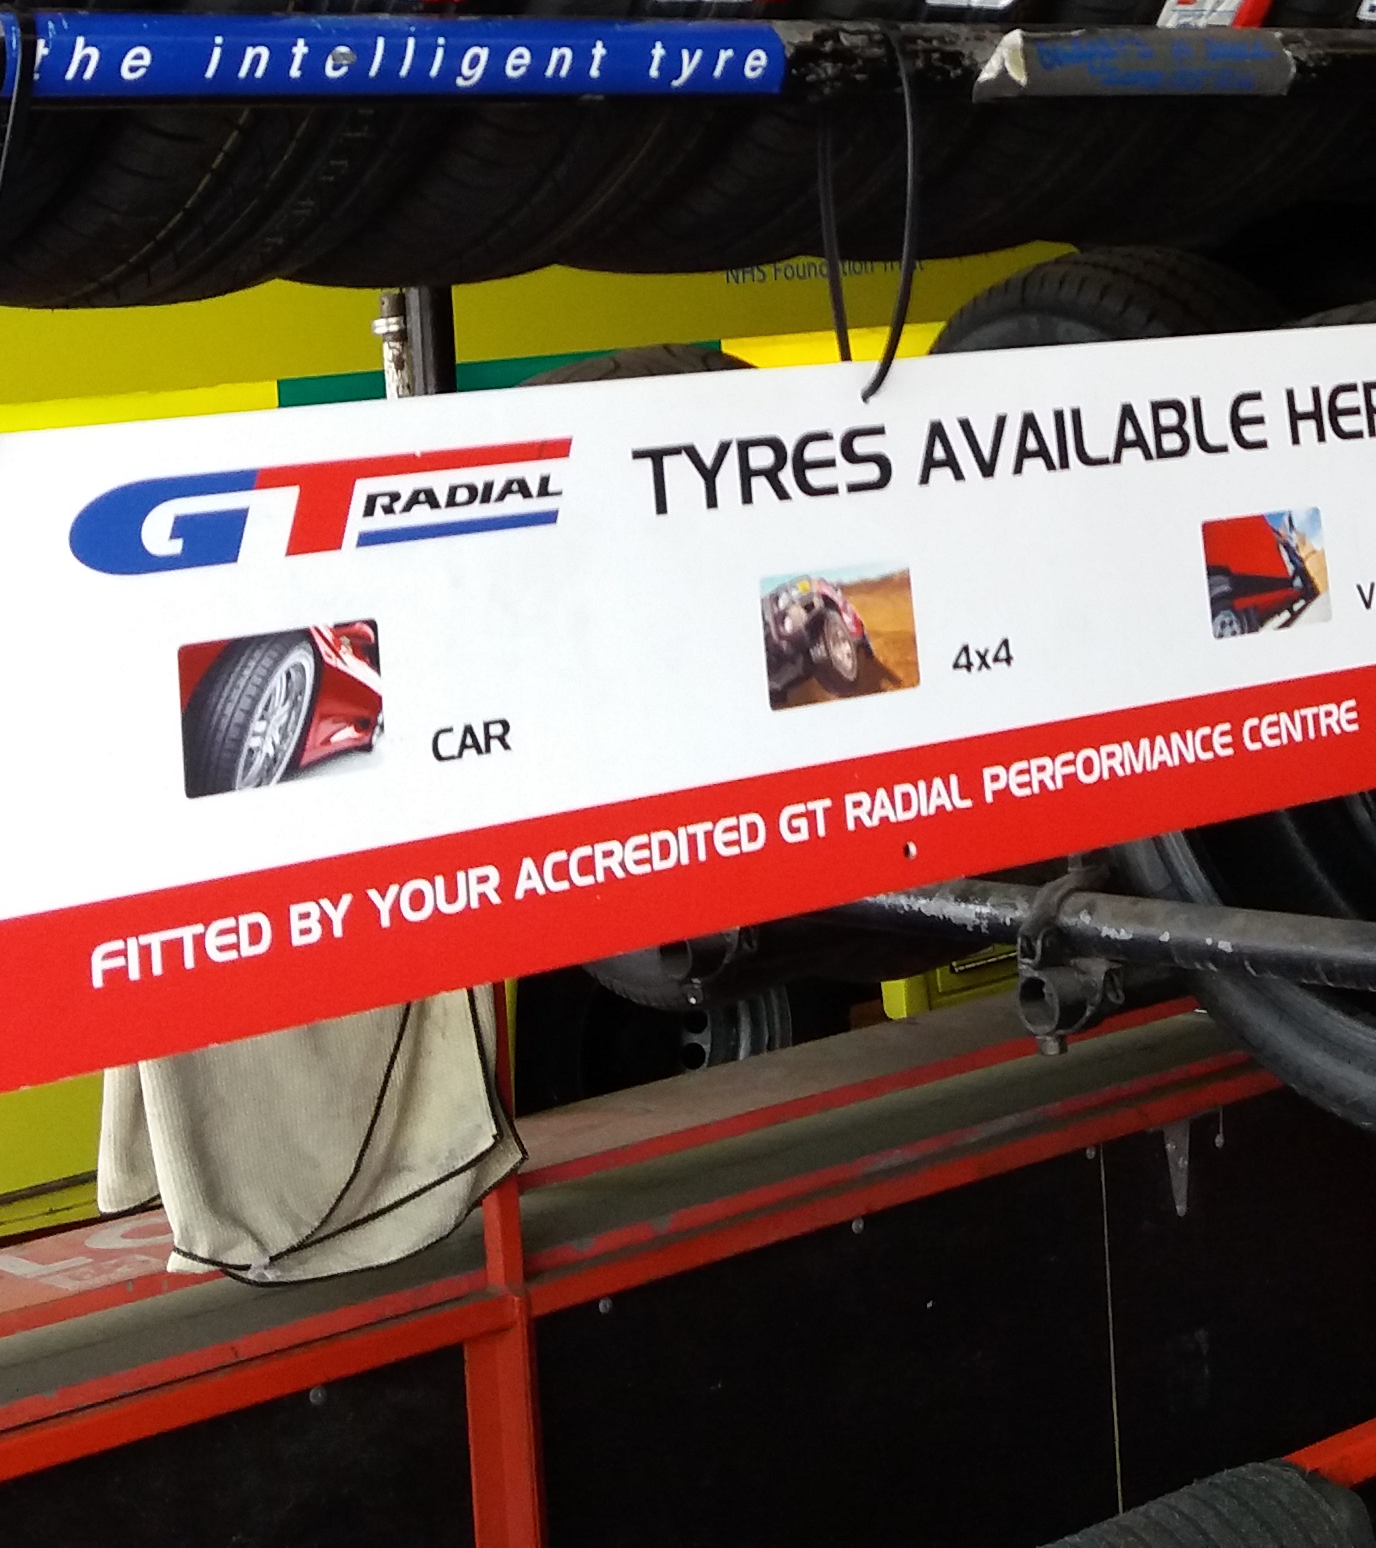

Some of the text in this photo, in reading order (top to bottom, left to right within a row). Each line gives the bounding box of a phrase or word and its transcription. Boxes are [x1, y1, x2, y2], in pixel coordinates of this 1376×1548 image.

[34, 36, 770, 89] the intelligent tyre
[631, 424, 893, 516] TYRES
[918, 390, 1269, 486] AVAILABLE
[68, 436, 573, 575] GT RADIAL
[952, 637, 1014, 675] 4x4
[430, 718, 511, 762] CAR
[91, 699, 1359, 989] FITTED BY YOUR ACCREDITED GT RADIAL PERFORMANCE CENTRE
